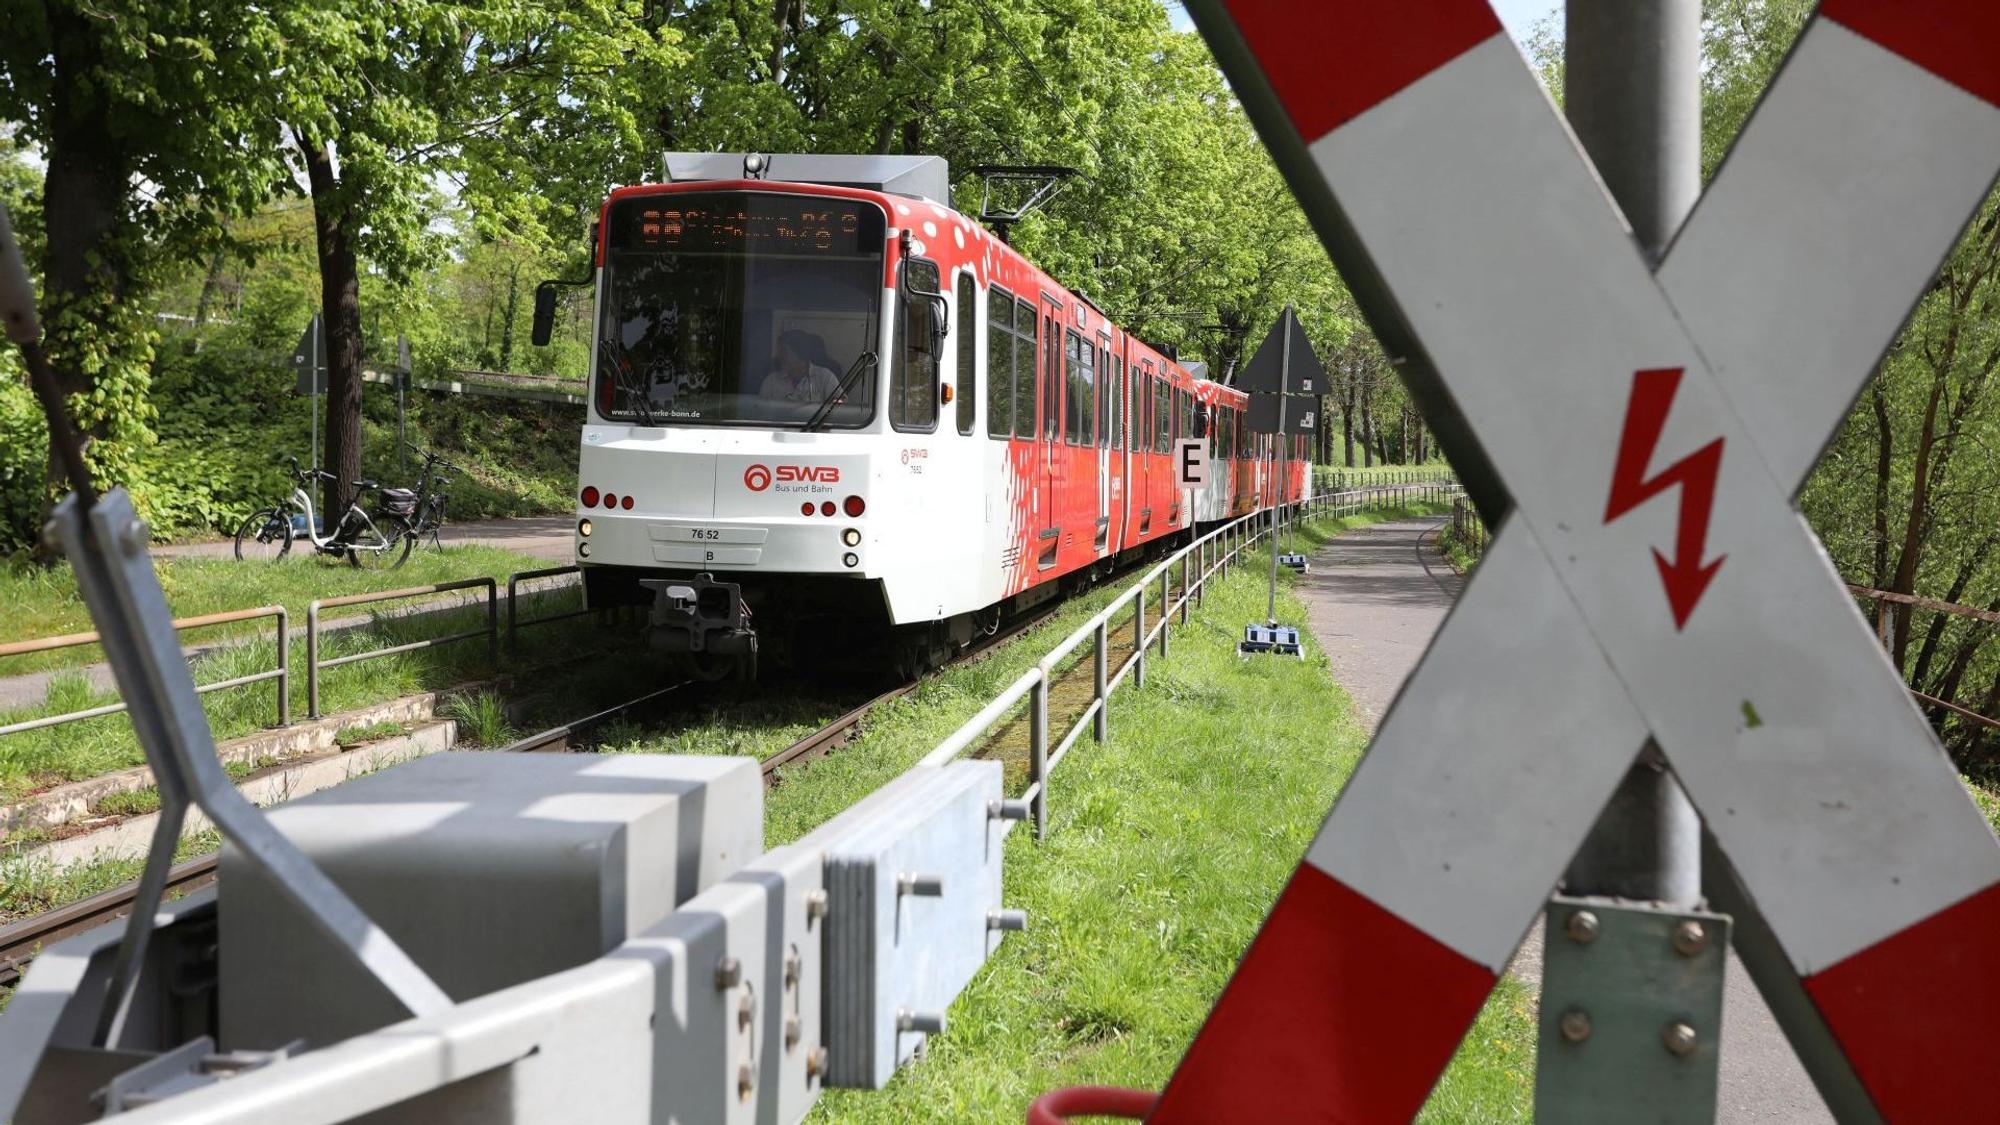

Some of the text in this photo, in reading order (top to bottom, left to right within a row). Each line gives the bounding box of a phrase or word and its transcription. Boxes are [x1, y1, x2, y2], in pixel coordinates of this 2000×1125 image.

[1182, 444, 1201, 483] E
[776, 465, 840, 483] SWB
[775, 484, 833, 494] Bus und Bahn
[706, 551, 714, 561] B
